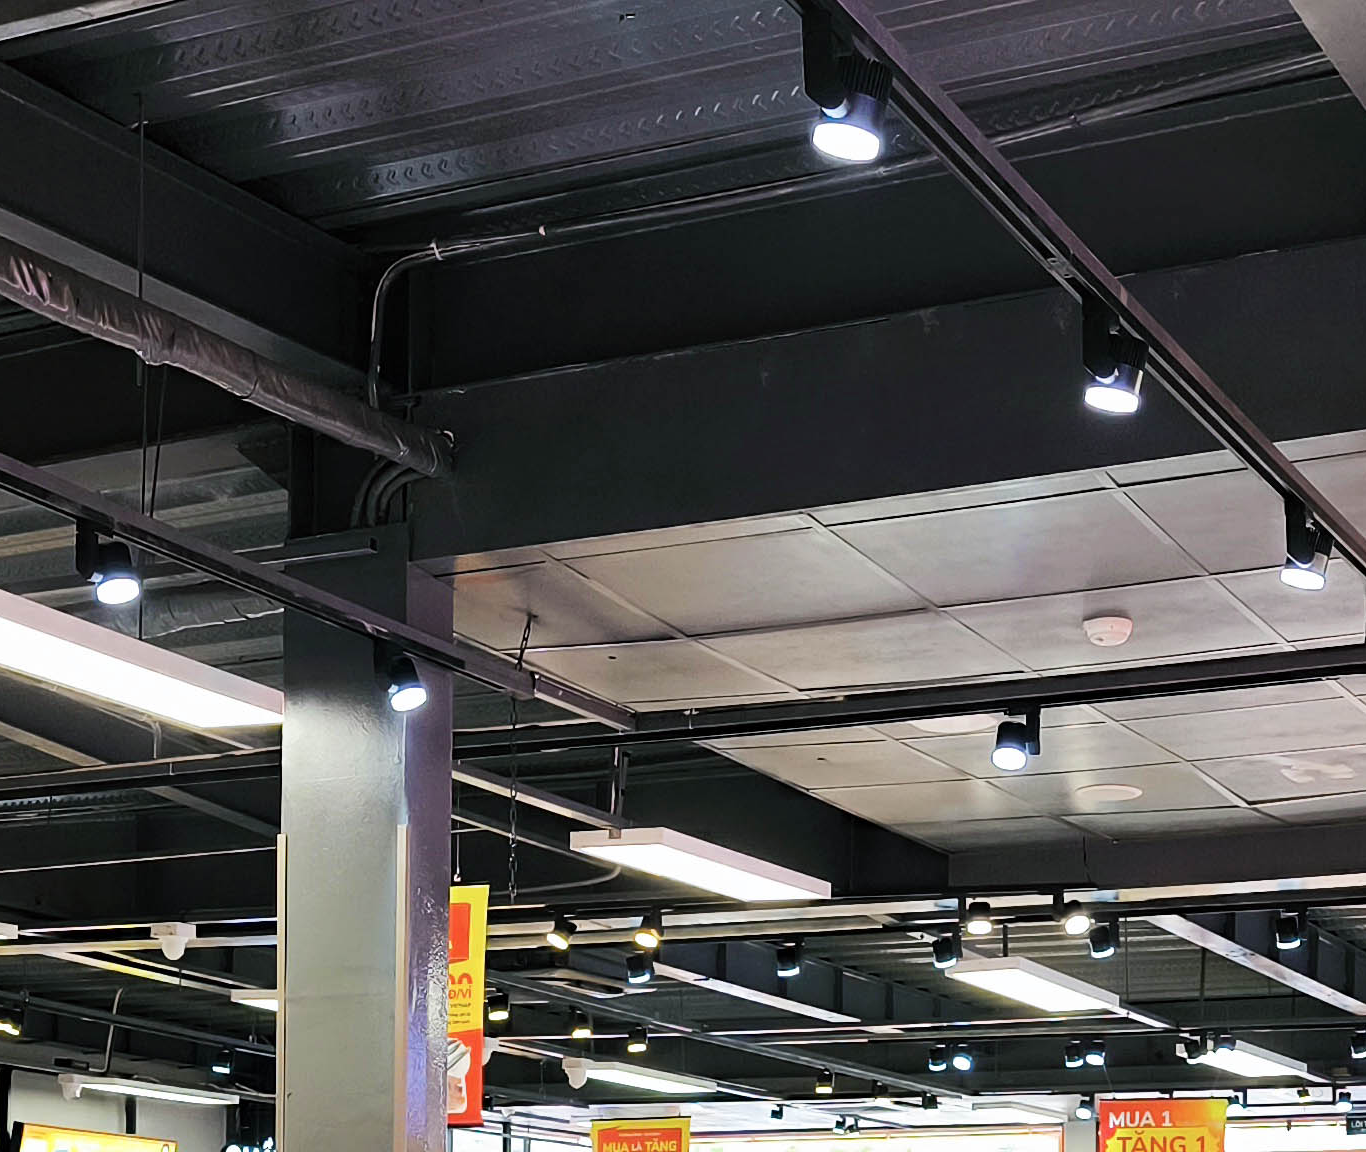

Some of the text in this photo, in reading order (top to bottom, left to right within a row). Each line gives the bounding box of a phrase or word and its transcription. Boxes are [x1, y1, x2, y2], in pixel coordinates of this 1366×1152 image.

[1109, 1110, 1173, 1128] MUA 1
[602, 1141, 629, 1152] MUA
